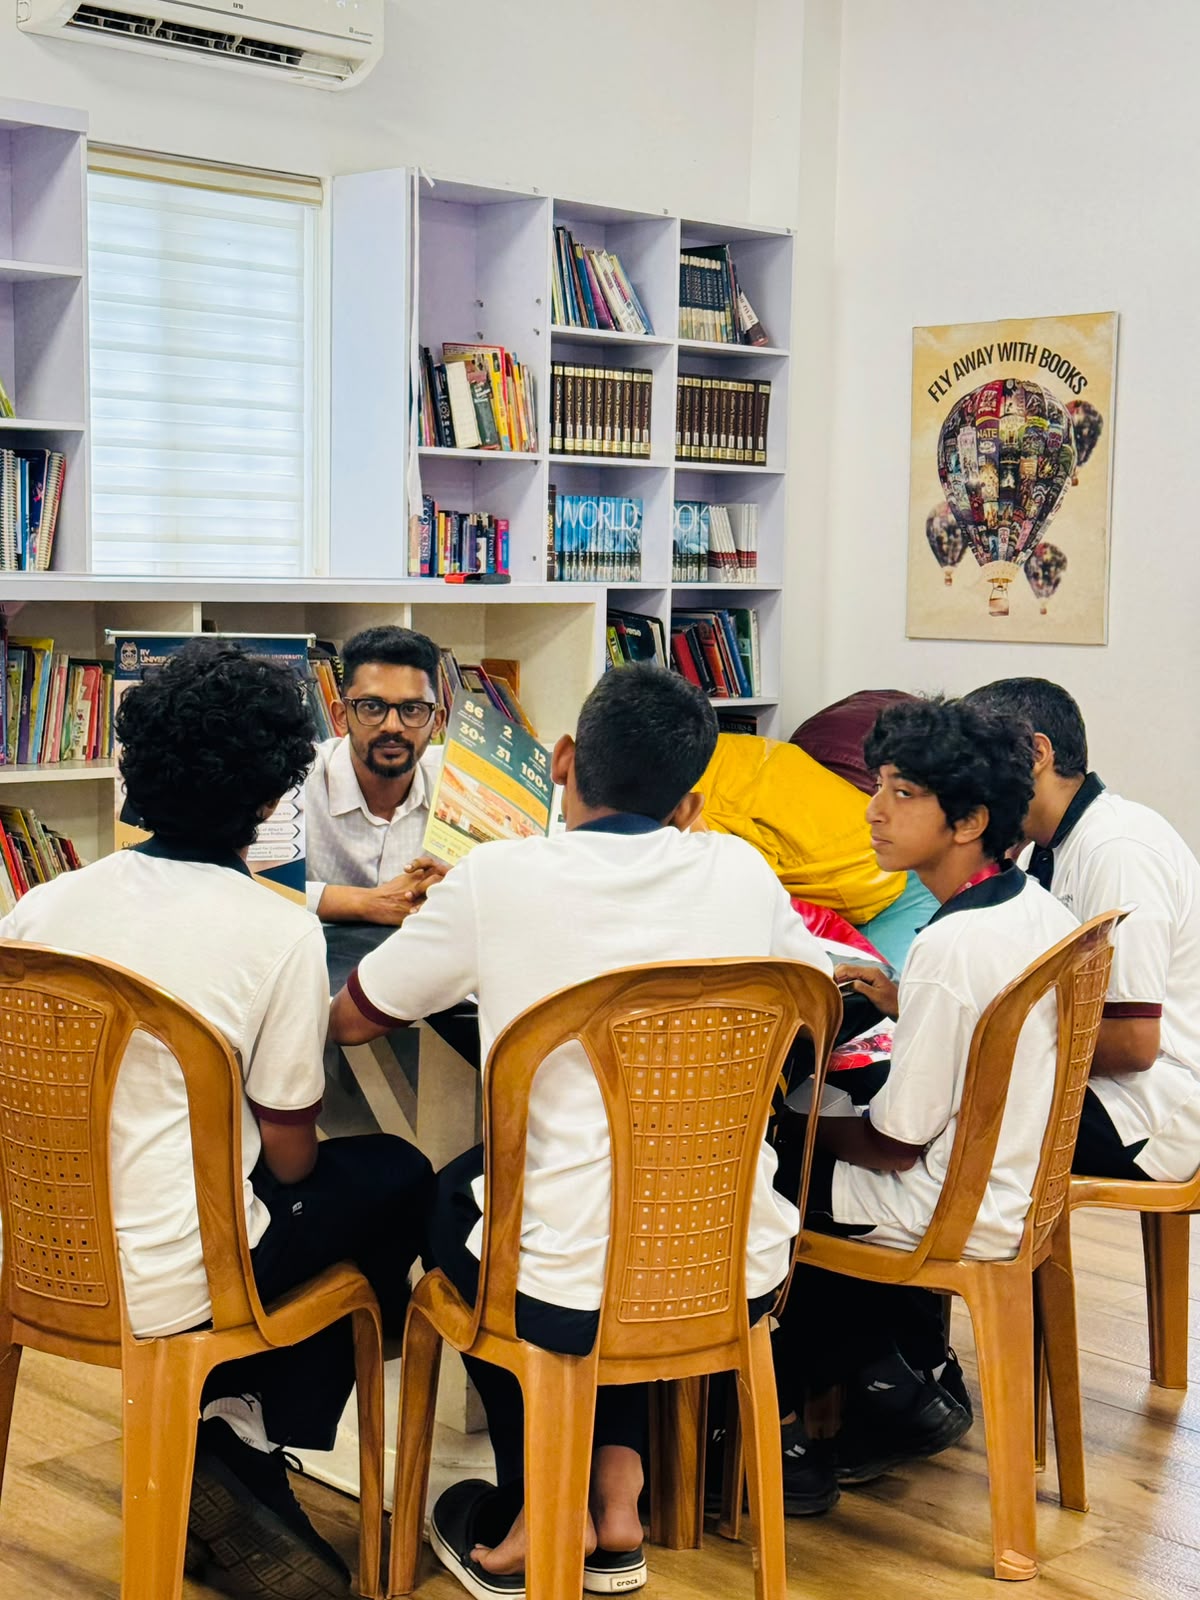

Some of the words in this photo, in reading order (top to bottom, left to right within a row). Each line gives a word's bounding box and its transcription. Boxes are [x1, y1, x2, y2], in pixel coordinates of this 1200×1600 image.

[927, 368, 953, 403] FLY
[952, 344, 994, 382] AWAY
[997, 341, 1038, 364] WITH
[1038, 347, 1088, 395] BOOKS
[977, 428, 998, 439] NATE
[555, 500, 639, 530] WORLD
[464, 700, 484, 719] 86
[460, 721, 486, 744] 30+
[503, 725, 513, 739] 2
[534, 748, 547, 767] 12
[521, 762, 549, 792] 100+
[616, 1578, 638, 1587] crocs
